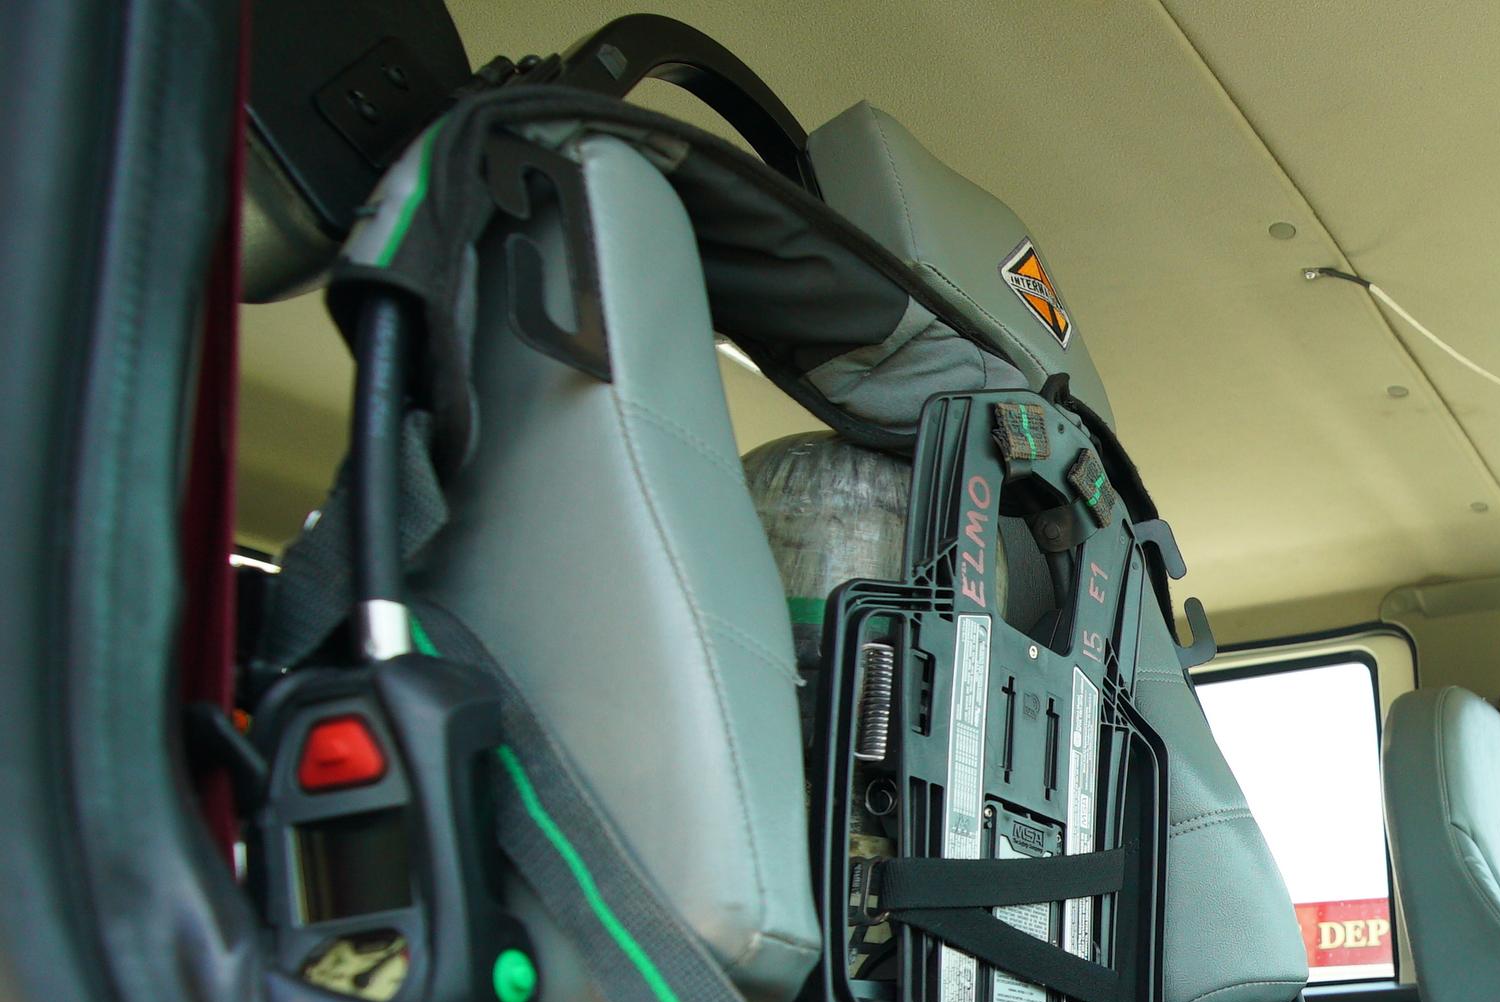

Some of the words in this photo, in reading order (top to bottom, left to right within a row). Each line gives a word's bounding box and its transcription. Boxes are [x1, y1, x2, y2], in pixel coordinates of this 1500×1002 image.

[962, 475, 991, 607] ELMO
[1012, 822, 1044, 847] MSA
[1318, 919, 1390, 950] DEP
